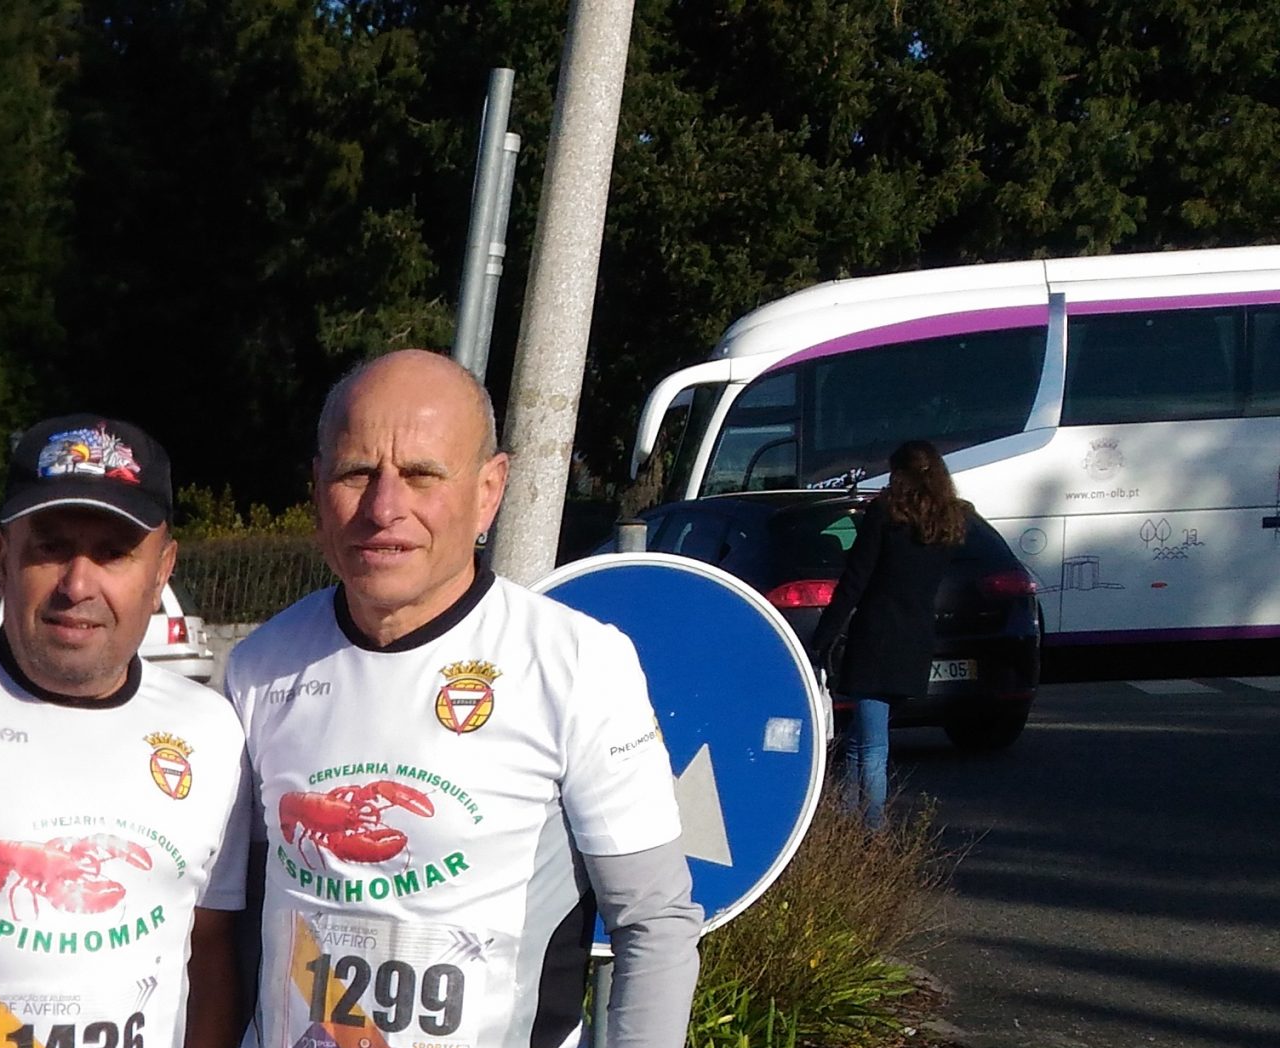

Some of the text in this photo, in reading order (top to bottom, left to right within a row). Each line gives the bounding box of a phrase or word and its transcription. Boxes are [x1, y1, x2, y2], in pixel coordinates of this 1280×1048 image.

[1065, 488, 1139, 500] www.cm-olb.pt
[308, 762, 485, 825] CERVEJARIA MARISQUEIRA
[32, 815, 188, 880] ERVEJARIA MARISQUEIRA
[274, 846, 471, 903] ESPINHOMAR
[305, 953, 466, 1037] 1299
